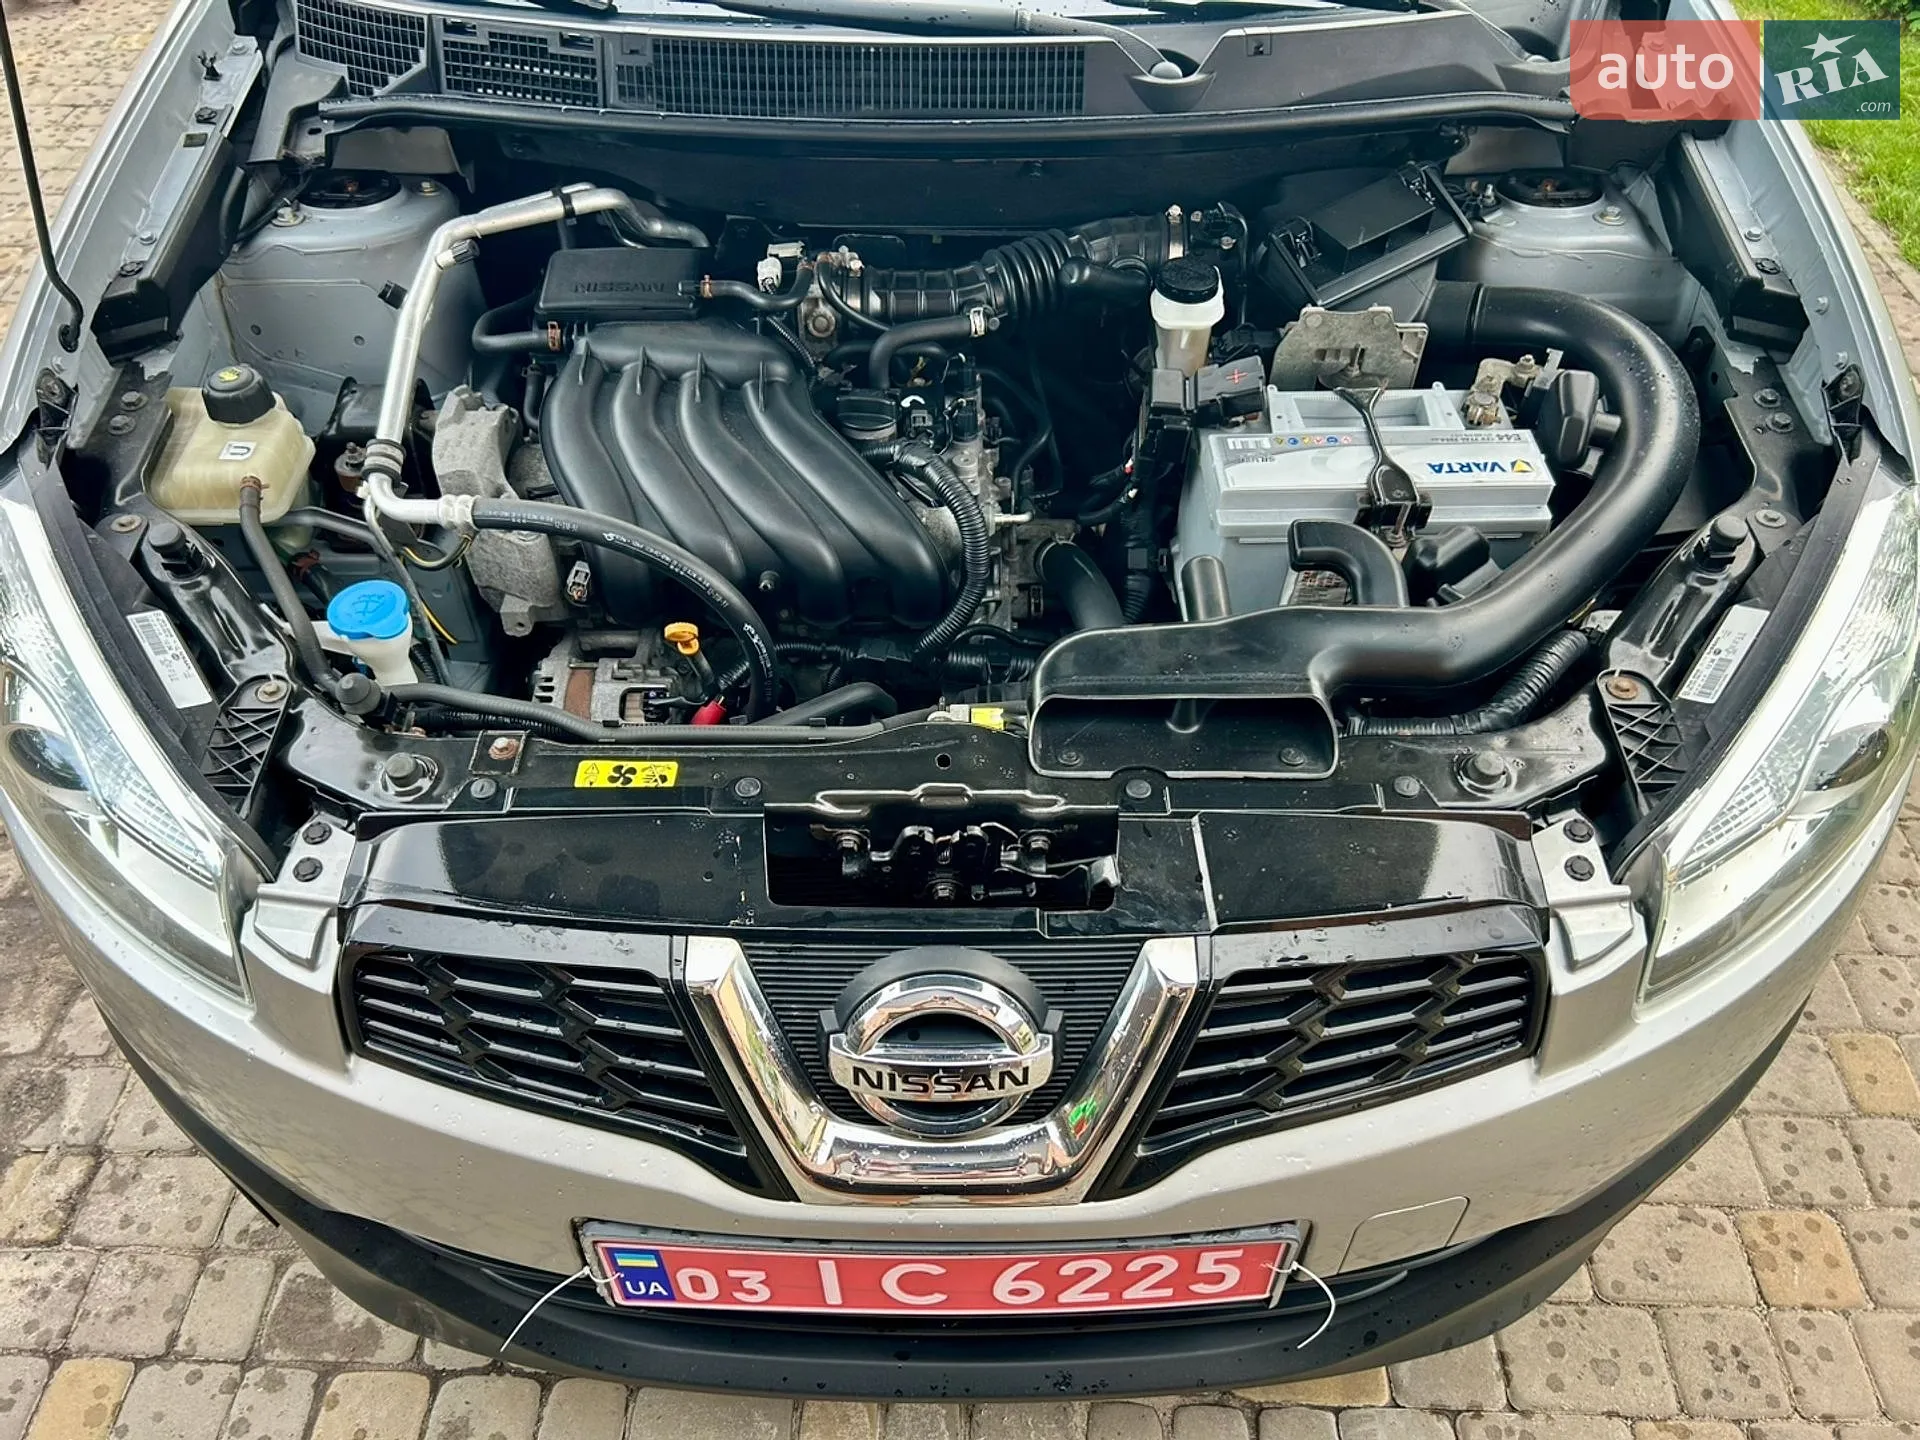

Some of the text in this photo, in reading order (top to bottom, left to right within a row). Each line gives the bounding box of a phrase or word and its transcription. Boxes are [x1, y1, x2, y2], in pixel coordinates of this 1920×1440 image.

[574, 281, 665, 293] NISSAN
[1426, 461, 1507, 474] VARTA
[853, 1065, 1029, 1094] NISSAN
[625, 1281, 668, 1296] UA
[676, 1267, 771, 1303] 03
[993, 1249, 1243, 1305] 6225
